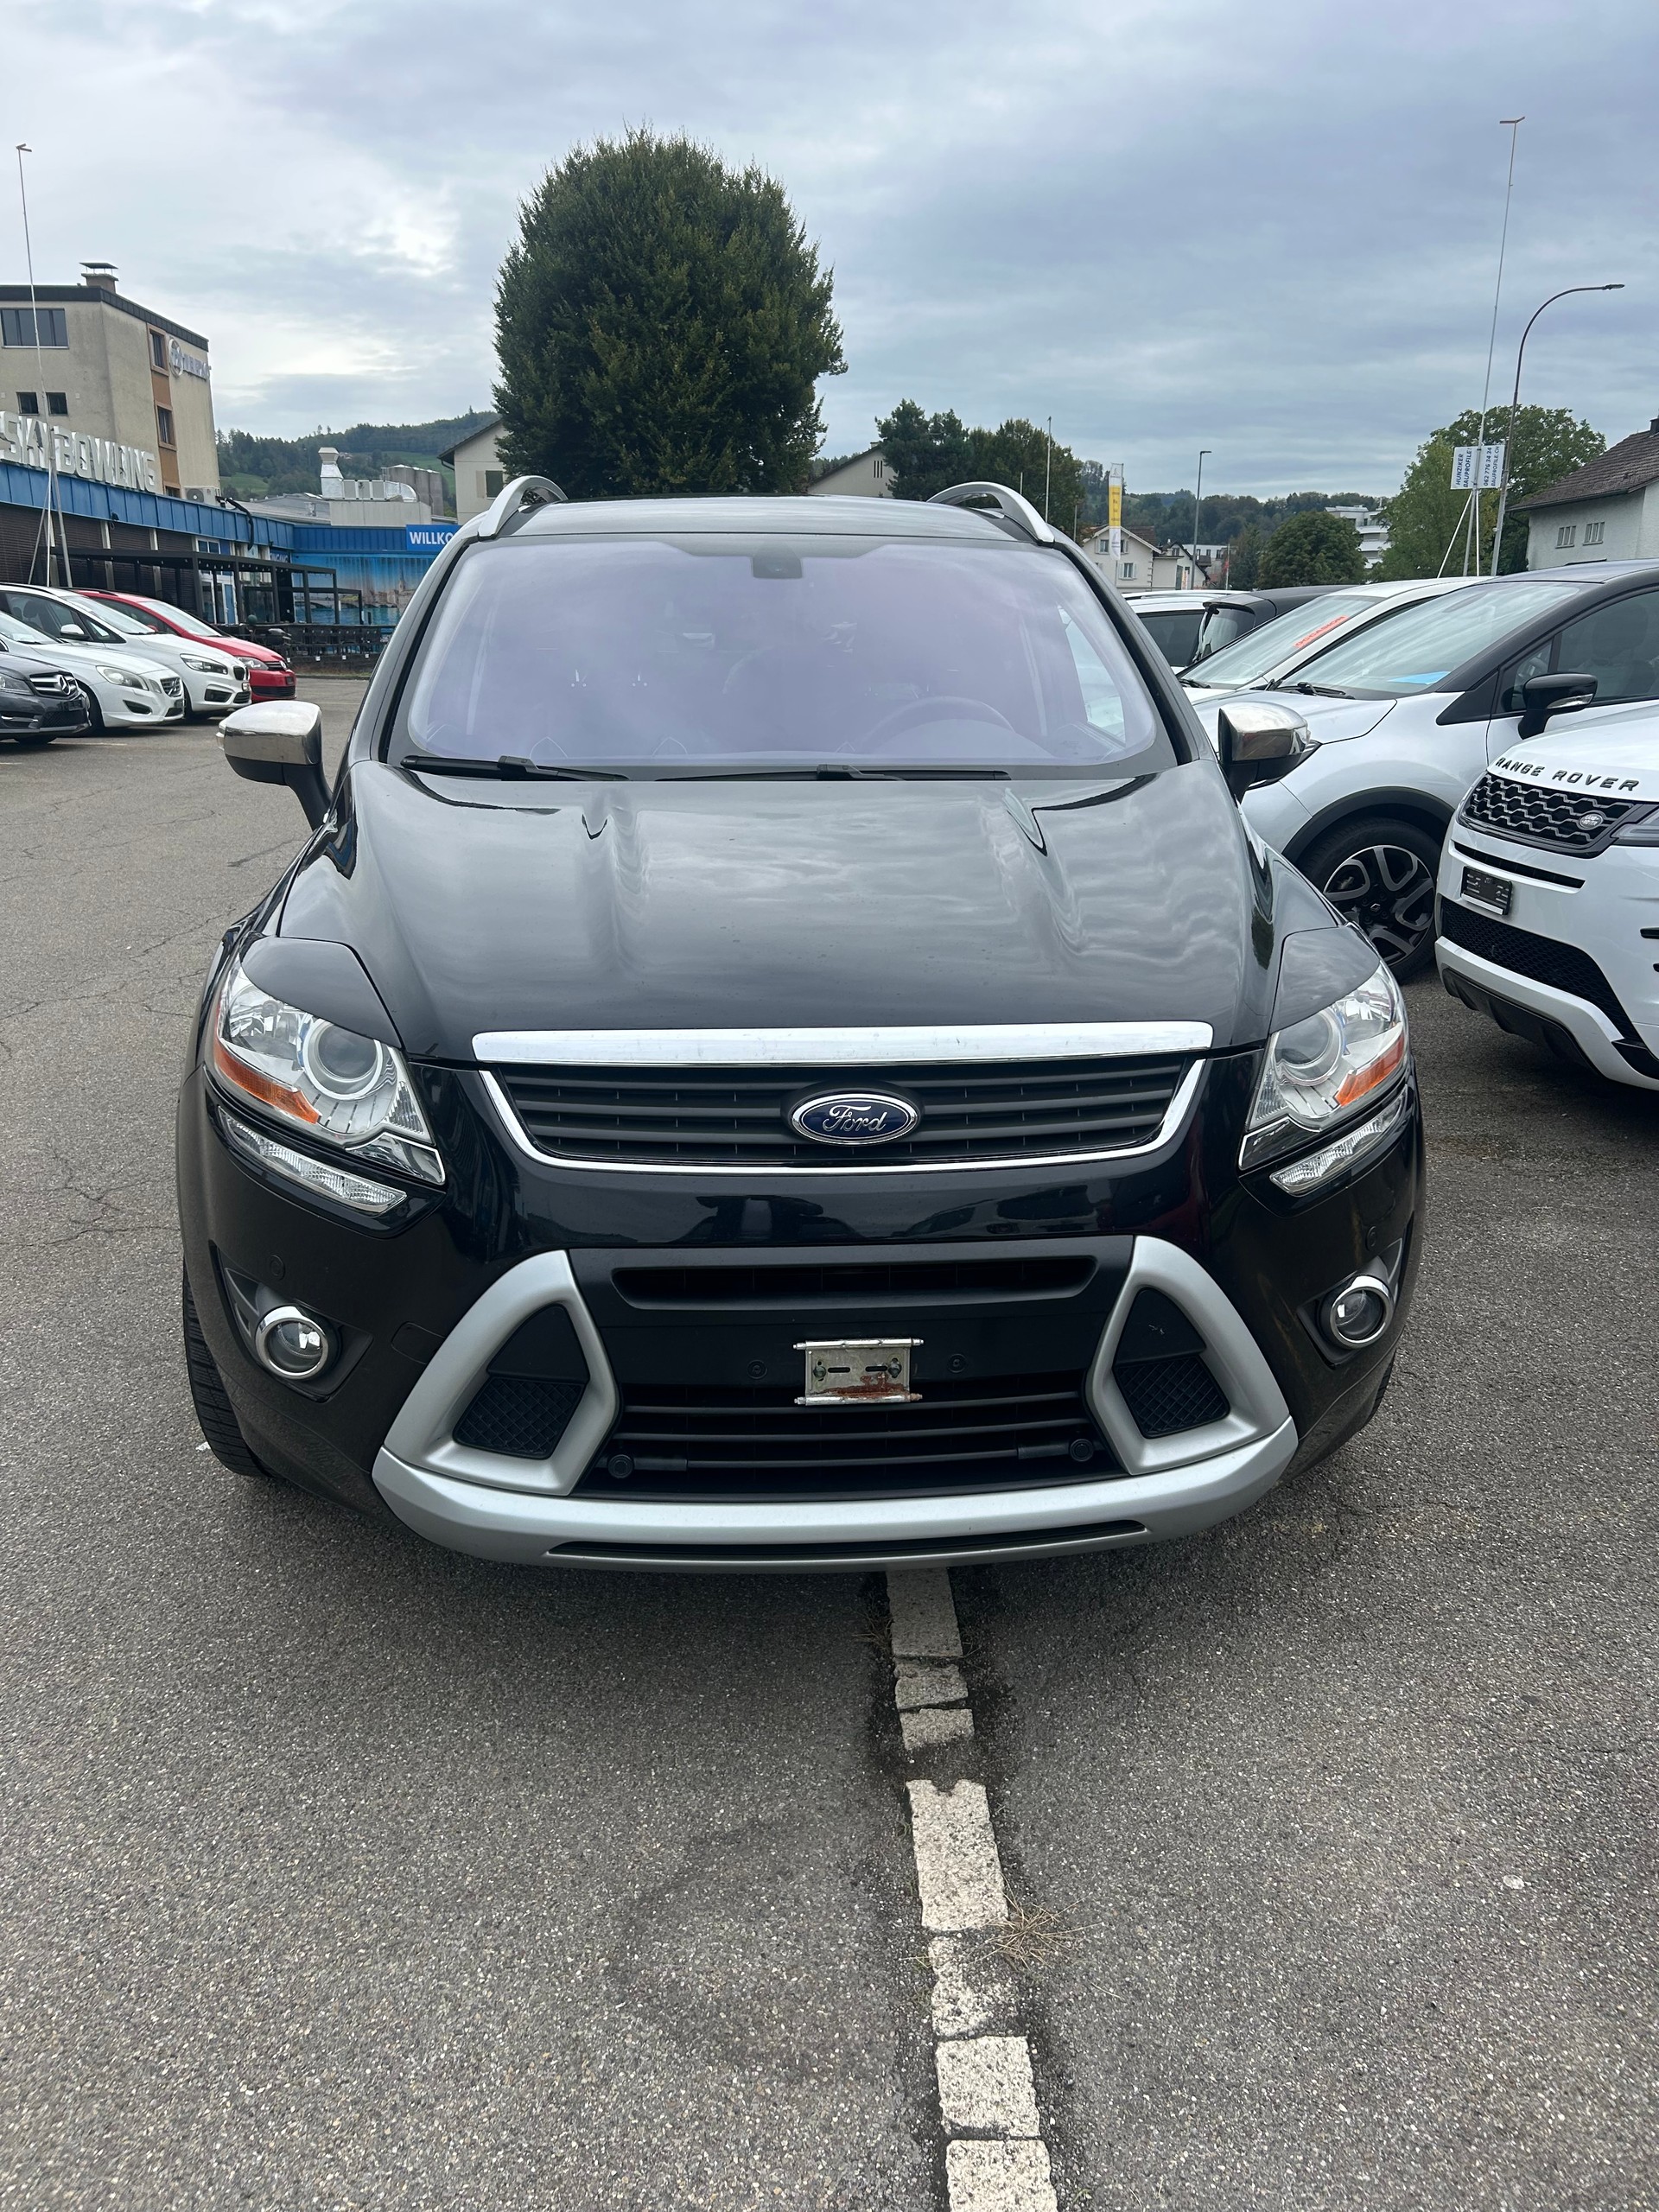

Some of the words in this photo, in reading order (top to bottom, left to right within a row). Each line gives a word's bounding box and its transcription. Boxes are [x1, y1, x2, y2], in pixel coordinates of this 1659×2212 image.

[53, 425, 156, 494] BOWLING
[1495, 757, 1545, 777] RANGE
[1551, 769, 1640, 791] ROVER
[822, 1104, 888, 1132] Ford
